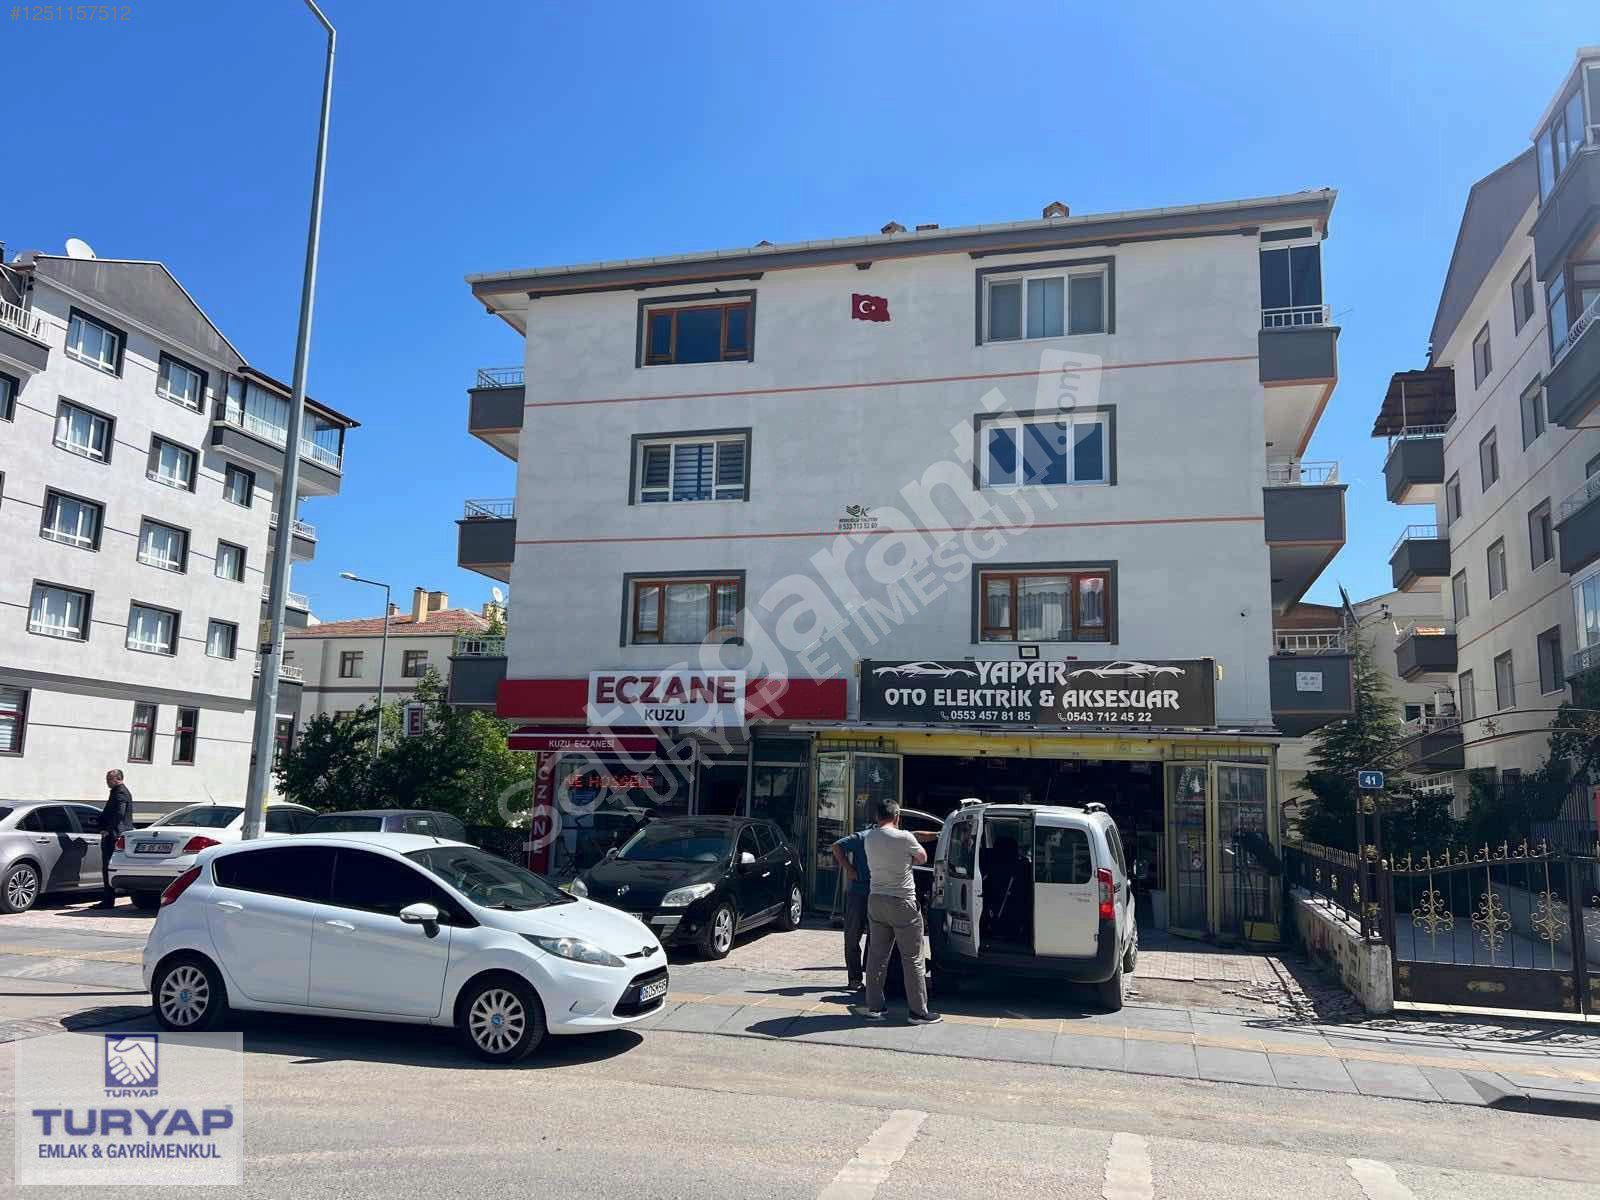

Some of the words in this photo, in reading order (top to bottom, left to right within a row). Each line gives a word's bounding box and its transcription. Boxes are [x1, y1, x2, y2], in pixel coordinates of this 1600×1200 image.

[975, 661, 1068, 686] YAPAR
[595, 675, 737, 704] ECZANE
[884, 688, 926, 706] OTO
[934, 686, 1032, 708] ELEKTRİK
[1039, 690, 1055, 707] &
[1062, 689, 1180, 710] AKSESUAR
[644, 708, 686, 722] KUZU
[950, 711, 976, 720] 0553
[978, 711, 999, 720] 457
[1001, 711, 1015, 720] 81
[1017, 711, 1031, 720] 85
[1066, 712, 1094, 722] 0543
[1097, 712, 1118, 722] 712
[1121, 713, 1136, 722] 45
[1137, 713, 1152, 722] 22
[549, 740, 570, 748] KUZU
[1365, 775, 1376, 785] 41
